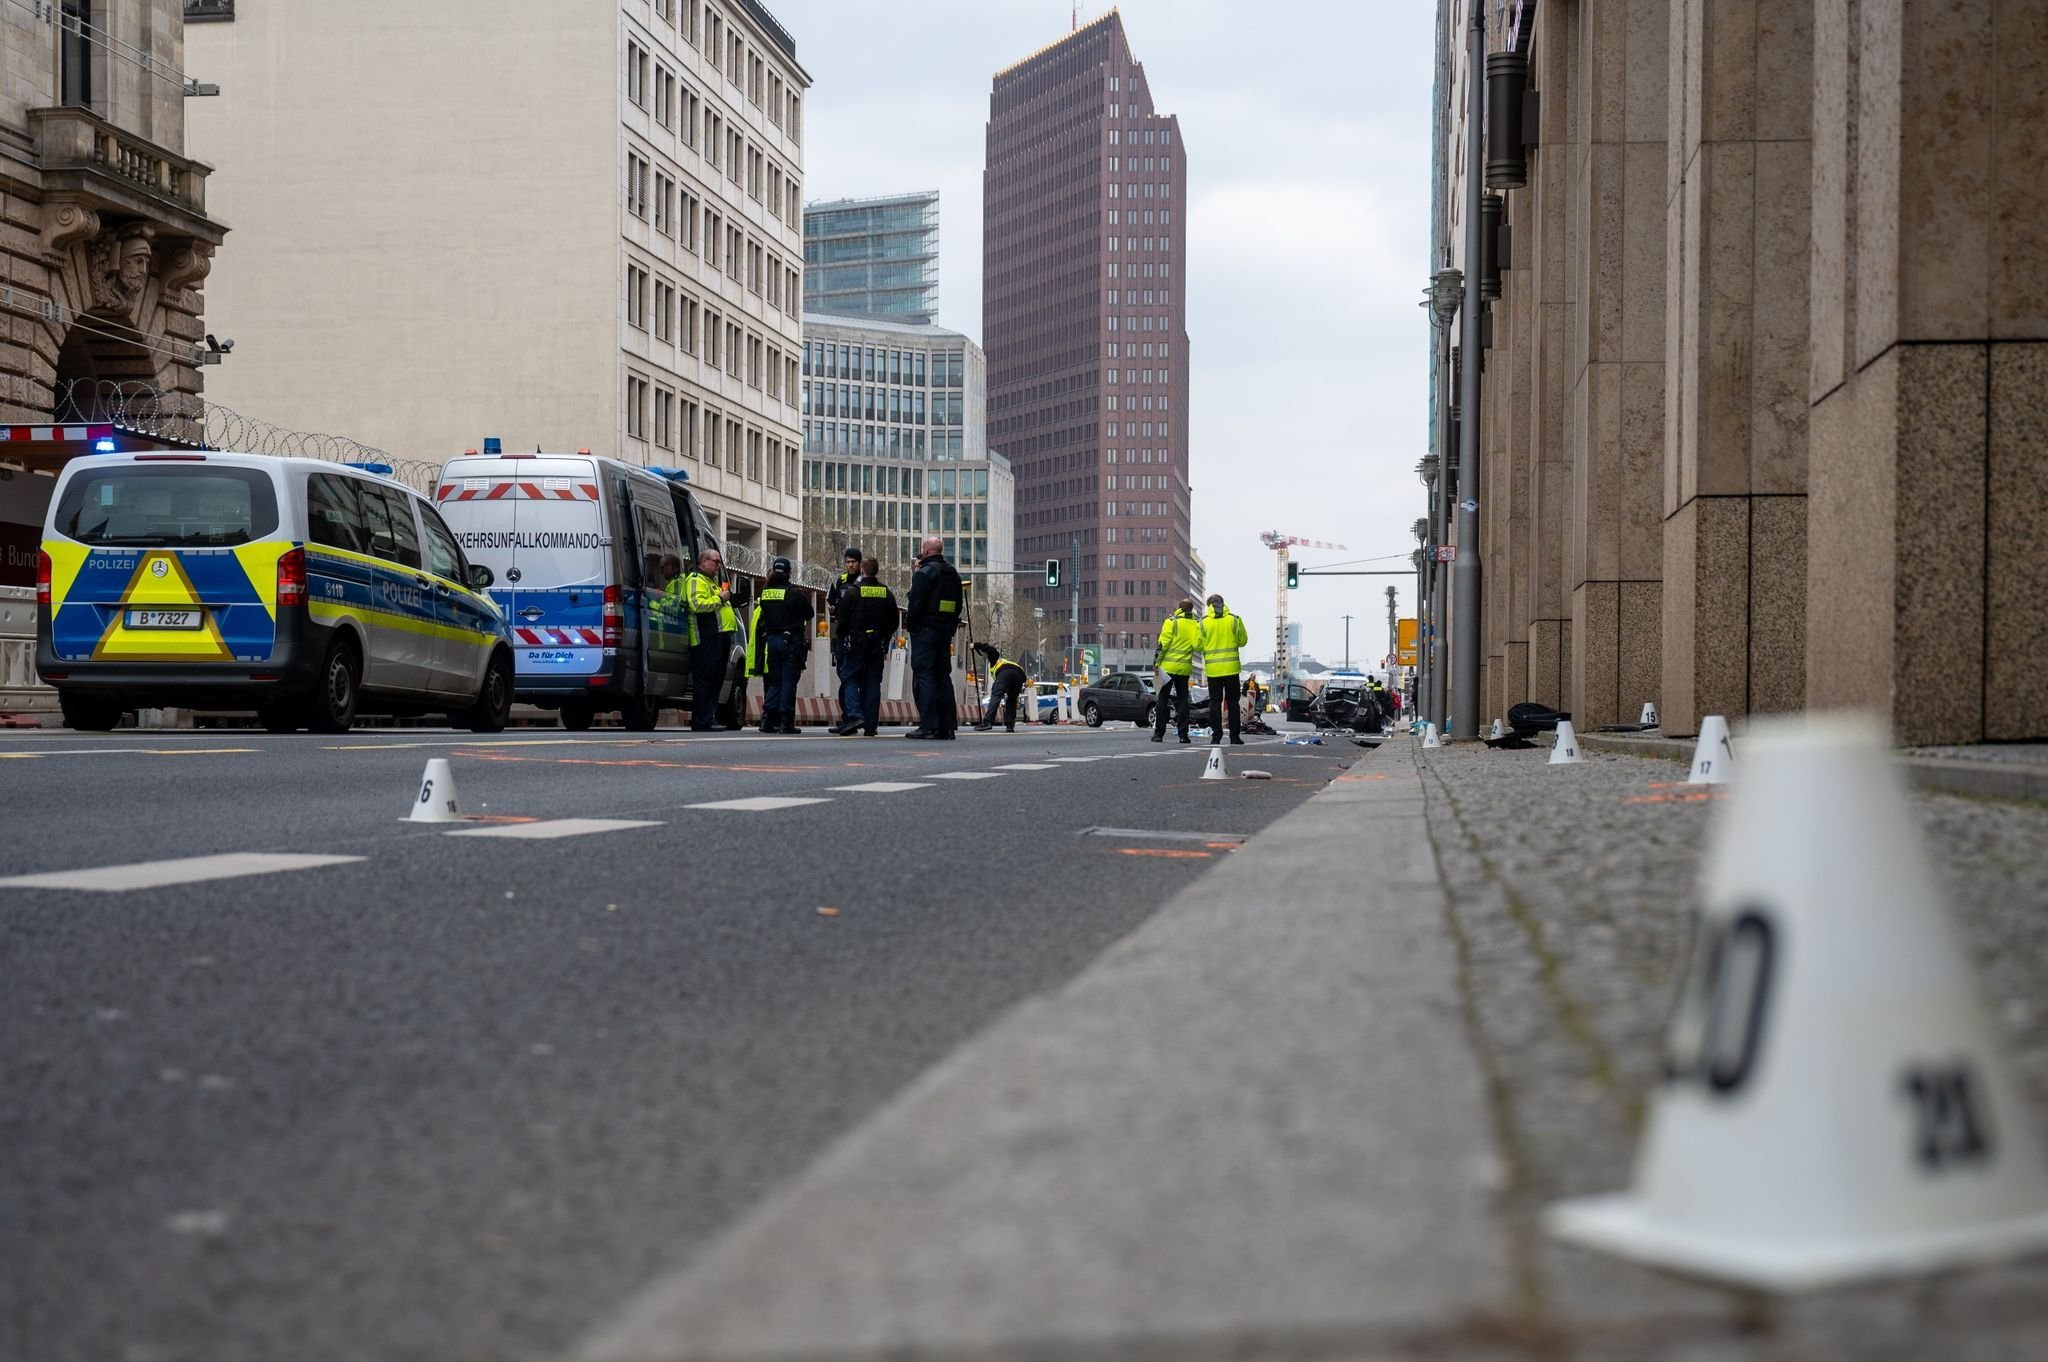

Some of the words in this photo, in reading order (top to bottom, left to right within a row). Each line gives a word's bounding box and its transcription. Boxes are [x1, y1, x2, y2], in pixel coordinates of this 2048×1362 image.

[89, 559, 135, 570] POLIZEI
[382, 581, 423, 608] POLIZEI
[763, 589, 785, 599] POLIZEI
[862, 587, 886, 597] POLIZEI
[140, 612, 149, 625] B
[158, 612, 189, 625] 7327
[541, 651, 554, 659] für
[555, 651, 574, 659] Dich
[1645, 711, 1656, 723] 15
[1209, 758, 1219, 770] 14
[1700, 760, 1712, 774] 17
